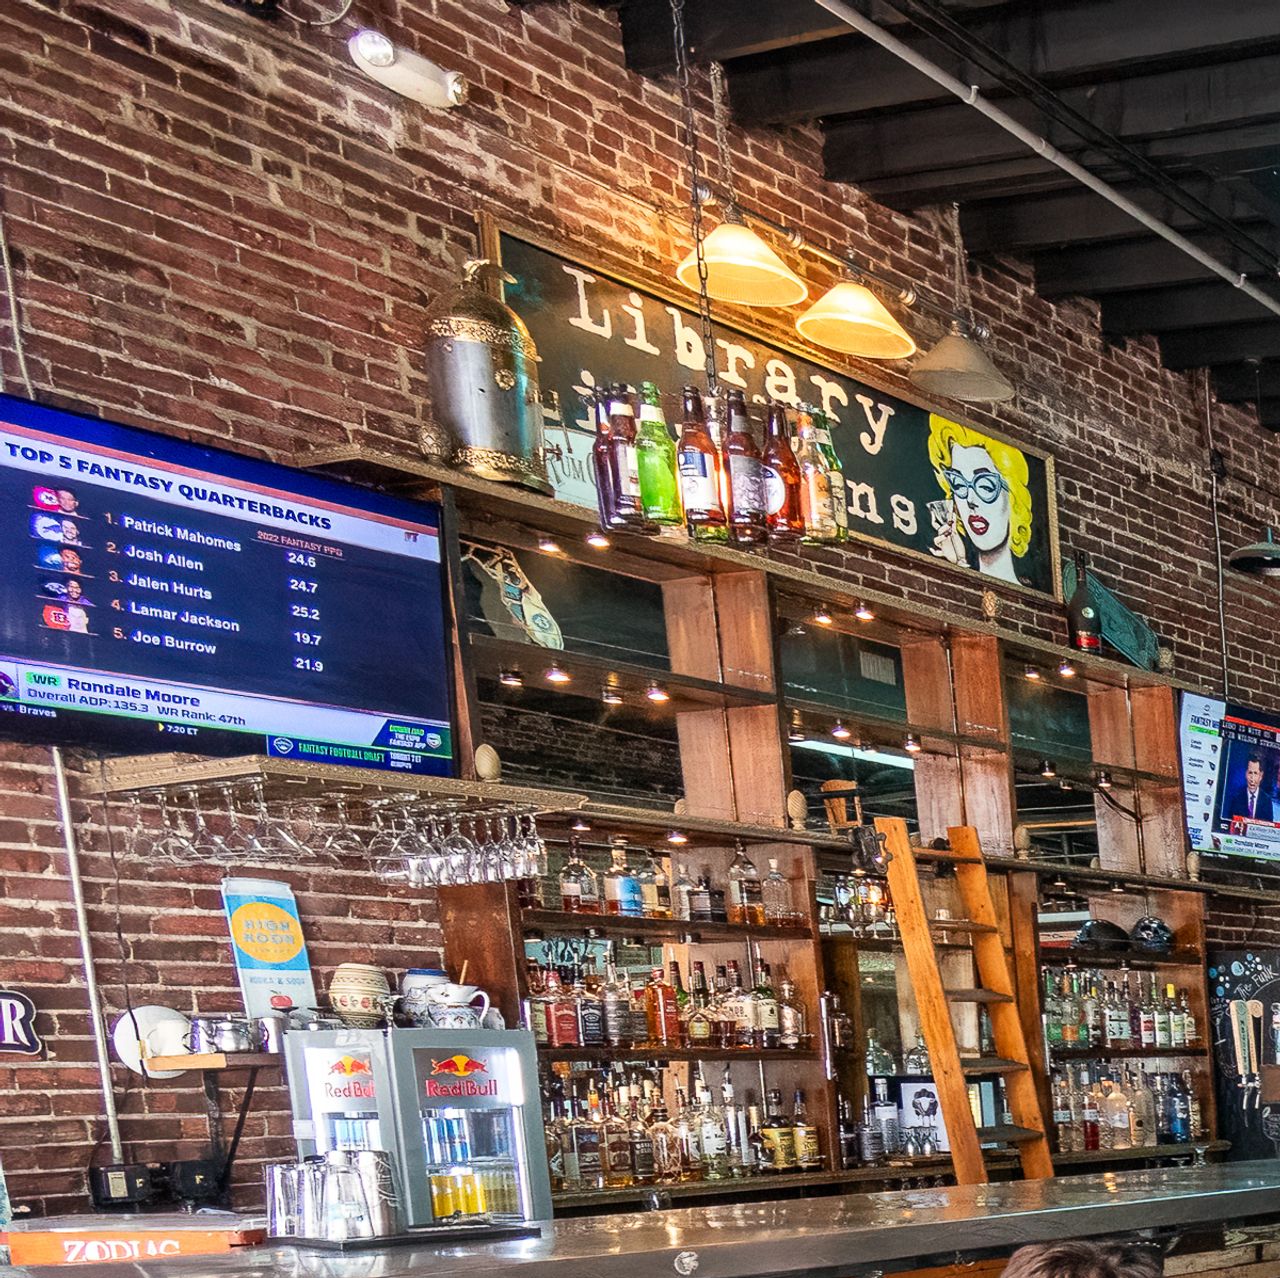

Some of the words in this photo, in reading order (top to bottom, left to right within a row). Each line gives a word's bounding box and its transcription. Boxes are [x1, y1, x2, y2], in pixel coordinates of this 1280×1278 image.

[562, 265, 897, 456] Library
[4, 441, 54, 464] TOP
[59, 455, 72, 470] 5
[77, 459, 174, 493] FANTASY
[178, 483, 332, 530] QUARTERBACKS
[104, 511, 118, 526] 1.
[123, 515, 174, 538] Patrick
[176, 527, 242, 552] Mahomes
[281, 535, 323, 552] FANTASY
[106, 541, 120, 554] 2.
[126, 545, 163, 564] Josh
[167, 553, 204, 571] Allen
[288, 551, 317, 568] 24.6
[108, 570, 124, 583] 3.
[128, 574, 169, 593] Jalen
[173, 581, 213, 600] Hurts
[290, 578, 319, 594] 24.7
[111, 599, 125, 612] 4.
[130, 601, 178, 621] Lamar
[181, 611, 241, 632] Jackson
[292, 605, 321, 621] 25.2
[113, 627, 127, 640] 5.
[133, 630, 161, 646] Joe
[164, 635, 217, 655] Burrow
[293, 631, 322, 646] 19.7
[295, 657, 324, 672] 21.9
[32, 673, 58, 686] WR
[67, 677, 142, 700] Rondale
[145, 689, 201, 708] Moore
[19, 704, 57, 719] Braves
[27, 687, 77, 704] Overall
[157, 705, 180, 718] WR
[181, 708, 216, 723] Rank:
[218, 713, 246, 726] 47th
[298, 742, 329, 756] FANTASY
[329, 746, 363, 760] FOOTBALL
[363, 751, 385, 763] DRAFT
[244, 919, 290, 931] HIGH
[324, 1081, 351, 1098] Red
[425, 1079, 463, 1097] Red
[466, 1079, 498, 1097] Bull
[62, 1239, 181, 1263] ZODIAC
